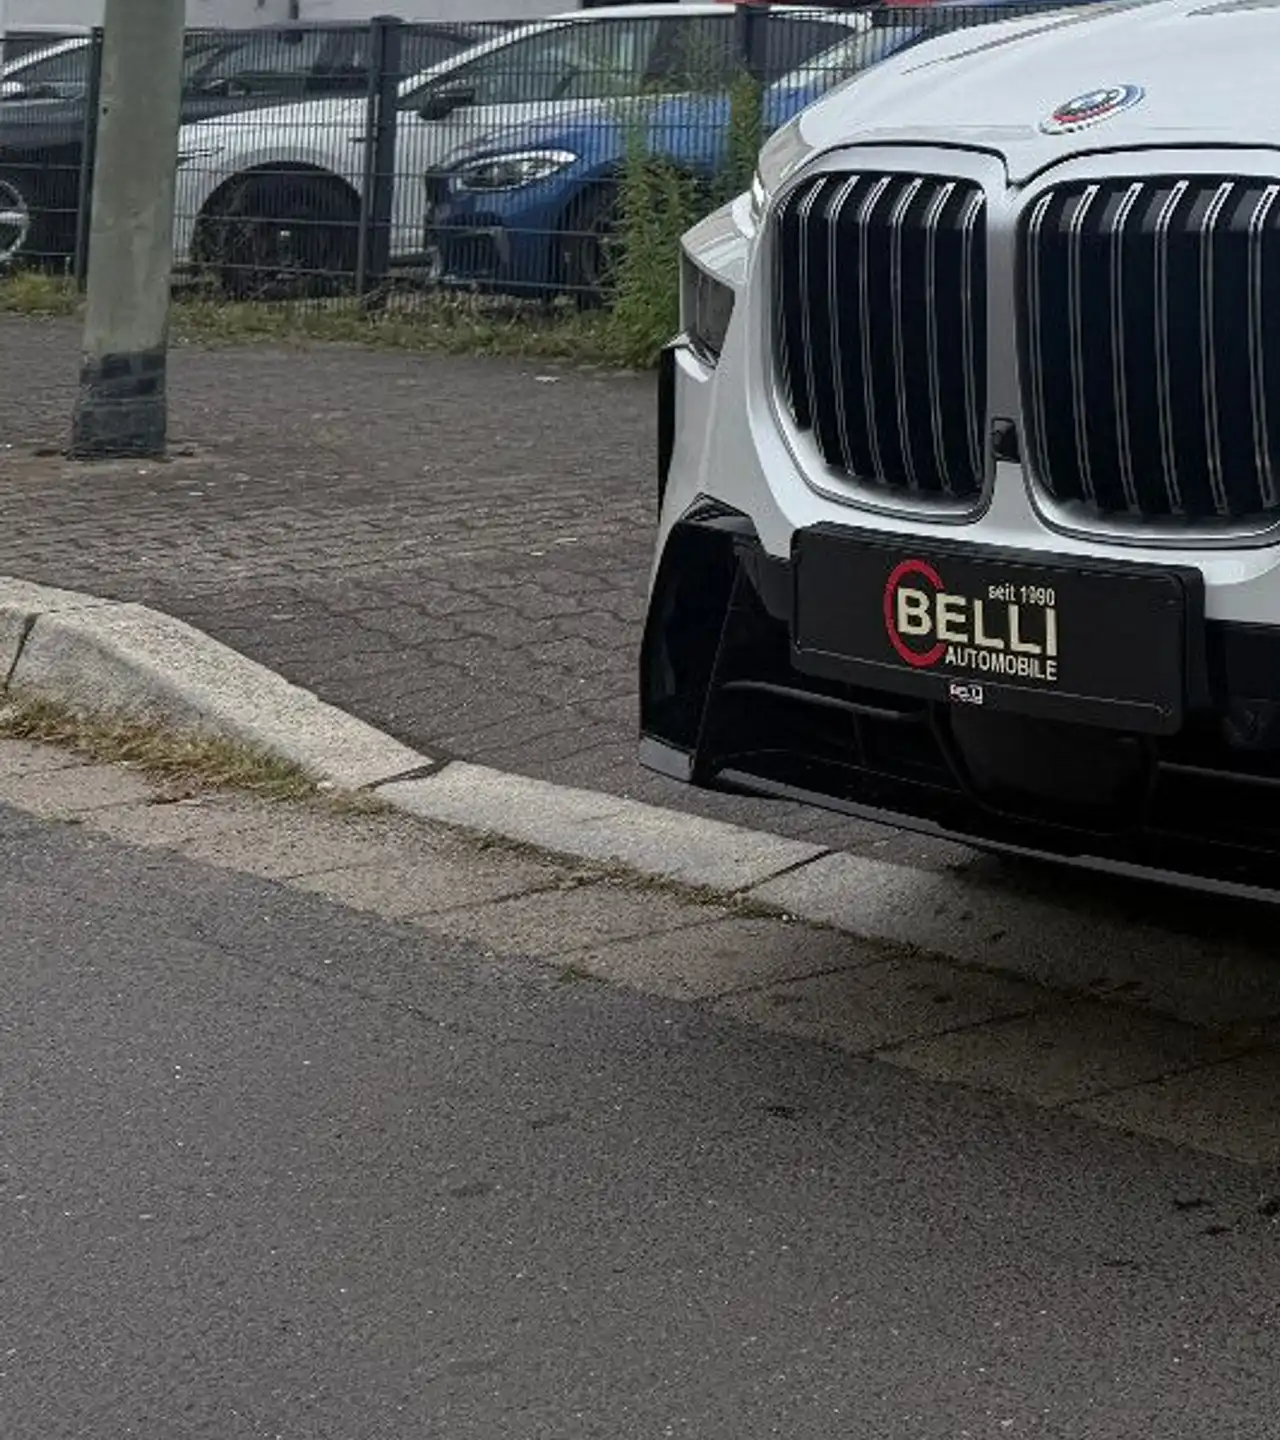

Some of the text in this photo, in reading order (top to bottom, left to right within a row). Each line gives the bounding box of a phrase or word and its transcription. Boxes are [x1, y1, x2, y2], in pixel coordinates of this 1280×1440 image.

[988, 583, 1056, 607] seit 1990
[897, 587, 1058, 657] BELLI
[945, 646, 1058, 681] AUTOMOBILE
